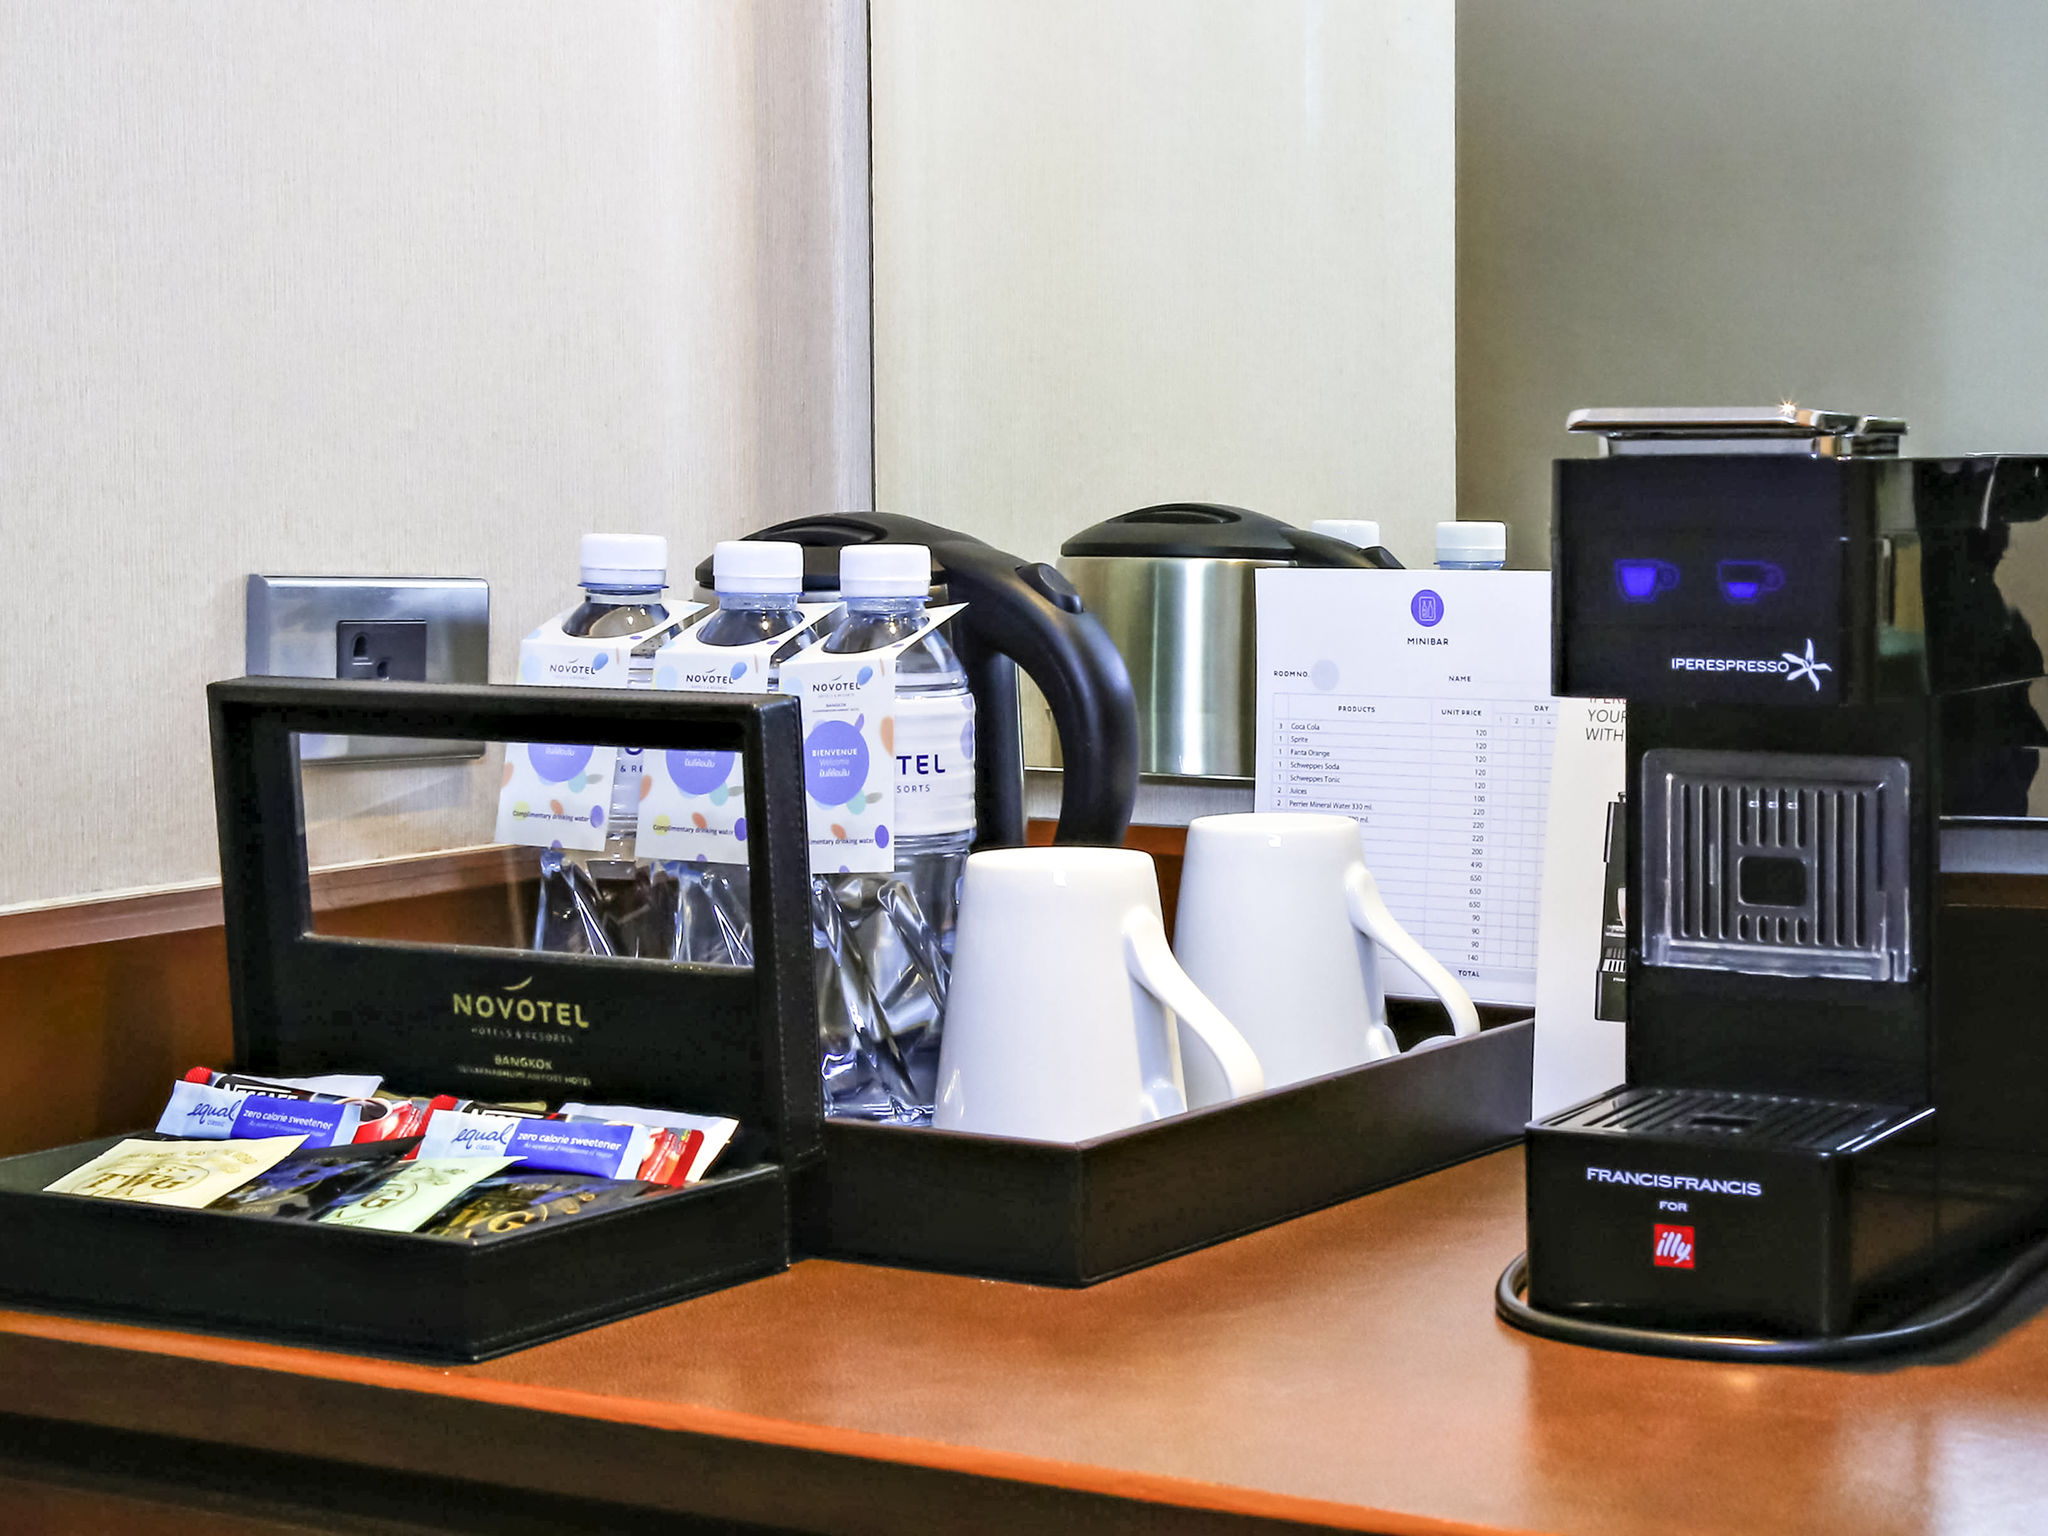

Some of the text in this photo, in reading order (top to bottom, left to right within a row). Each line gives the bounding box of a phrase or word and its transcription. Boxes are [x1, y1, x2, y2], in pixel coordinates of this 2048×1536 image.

[1407, 637, 1449, 646] MINIBAR
[549, 664, 596, 675] NOVOTEL
[1671, 658, 1789, 673] IPERESPRESSO
[686, 674, 734, 685] NOVOTEL
[812, 682, 861, 692] NOVOTEL
[1338, 705, 1376, 713] PRODUCTS
[1290, 723, 1320, 731] Coca Cola
[1585, 727, 1624, 742] WITH
[1475, 742, 1487, 750] 120
[812, 748, 857, 757] BIENVENUE
[896, 754, 946, 776] TEL
[896, 784, 930, 793] SORTS
[512, 810, 590, 822] Complimentary drinking water
[652, 824, 694, 834] Complimentary
[695, 826, 717, 836] drinking
[835, 837, 858, 846] drinking
[1472, 914, 1481, 922] 90
[1458, 969, 1480, 978] TOTAL
[453, 993, 589, 1028] NOVOTEL
[494, 1054, 553, 1070] BANGKOK
[186, 1099, 242, 1125] equal
[243, 1109, 262, 1120] zero
[262, 1111, 288, 1123] calorie
[288, 1114, 334, 1131] sweetener
[452, 1124, 514, 1150] equal
[516, 1131, 622, 1151] zero calorie sweetener
[1586, 1166, 1763, 1197] FRANCISFRANCIS
[1658, 1200, 1689, 1213] FOR
[1655, 1231, 1692, 1264] illy
